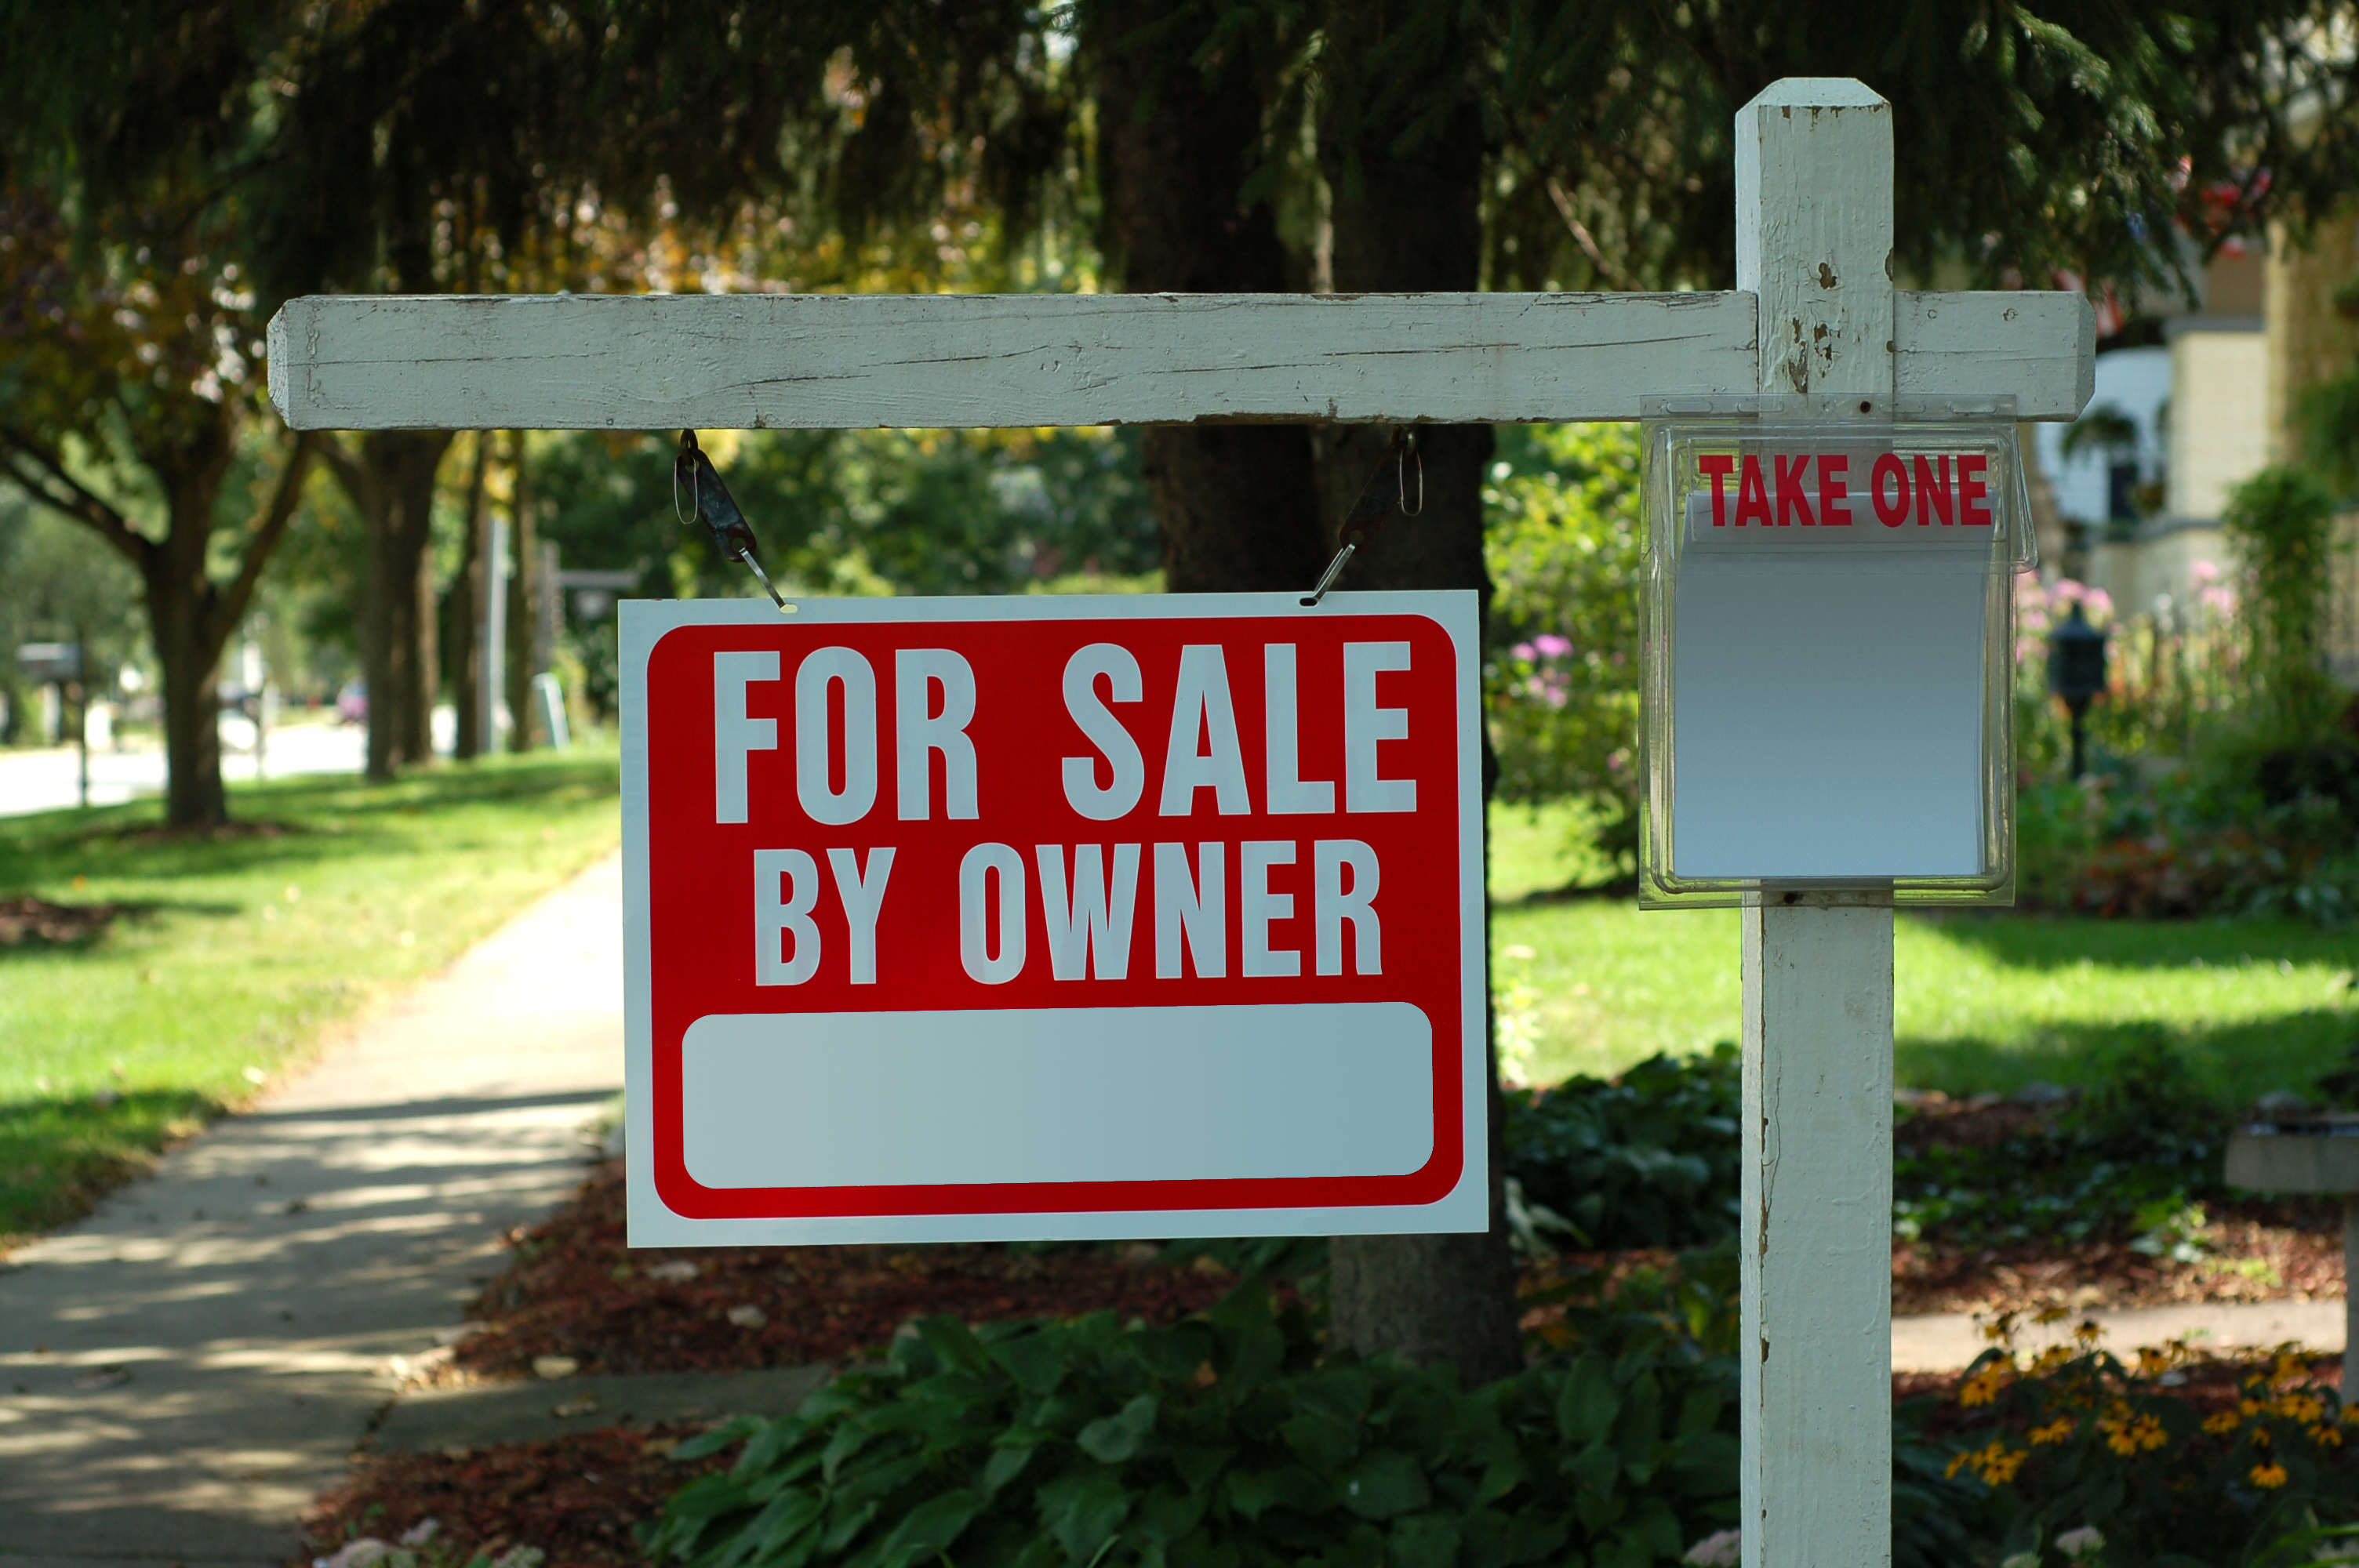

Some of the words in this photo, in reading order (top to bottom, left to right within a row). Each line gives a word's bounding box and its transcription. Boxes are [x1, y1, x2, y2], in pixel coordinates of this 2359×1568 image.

[1699, 455, 1852, 527] TAKE
[1870, 452, 1992, 528] ONE
[713, 645, 980, 826] FOR
[1061, 641, 1417, 821] SALE
[753, 847, 897, 987] BY
[958, 839, 1383, 985] OWNER
